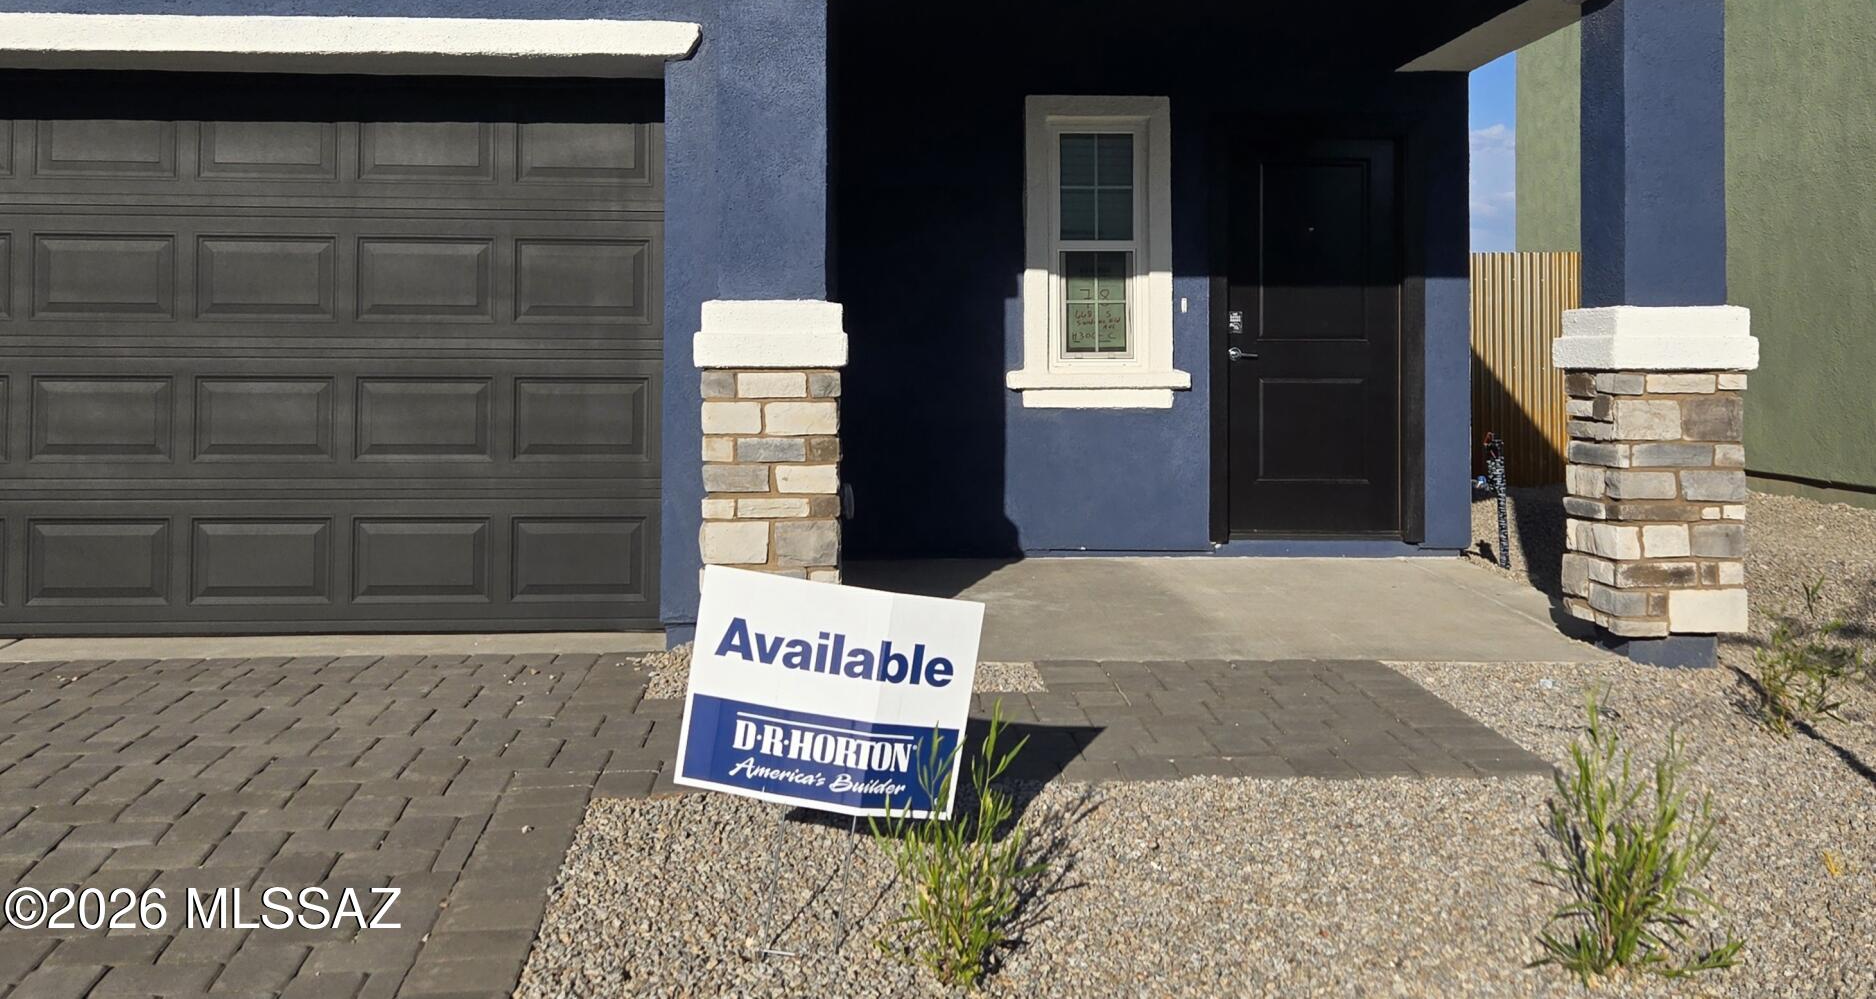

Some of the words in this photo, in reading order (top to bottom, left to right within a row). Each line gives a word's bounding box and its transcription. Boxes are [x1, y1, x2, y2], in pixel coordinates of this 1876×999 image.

[714, 616, 954, 688] Available
[729, 756, 826, 787] America's
[829, 773, 906, 796] Builder
